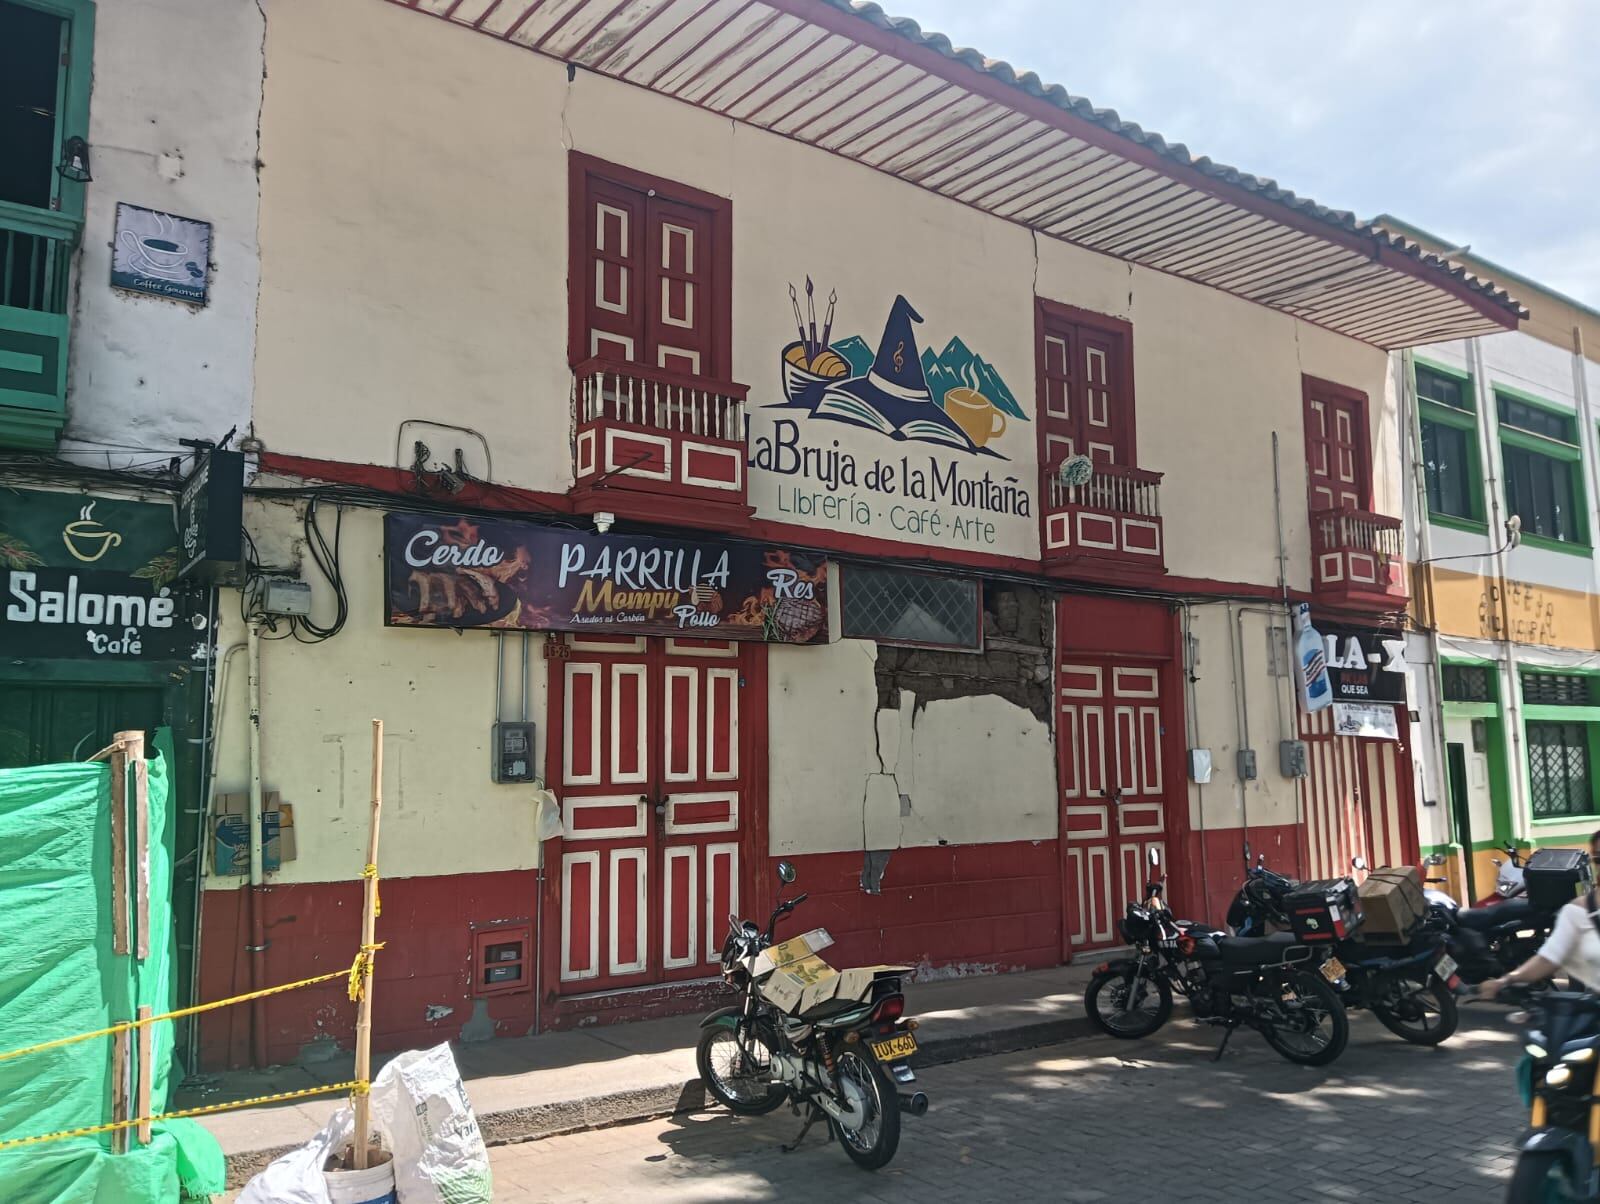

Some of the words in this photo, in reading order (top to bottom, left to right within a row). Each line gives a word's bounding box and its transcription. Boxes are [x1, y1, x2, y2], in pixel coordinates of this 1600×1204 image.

[133, 278, 162, 290] Coffee
[864, 458, 895, 494] de
[890, 505, 941, 537] Café
[952, 515, 995, 544] Arte
[404, 529, 504, 568] Cerdo
[557, 542, 731, 591] PARRILLA
[7, 570, 174, 628] Salomé
[766, 568, 815, 600] Res
[673, 604, 720, 629] Pollo
[90, 627, 142, 655] Café
[1341, 684, 1356, 694] QUE
[1356, 686, 1369, 694] SEA
